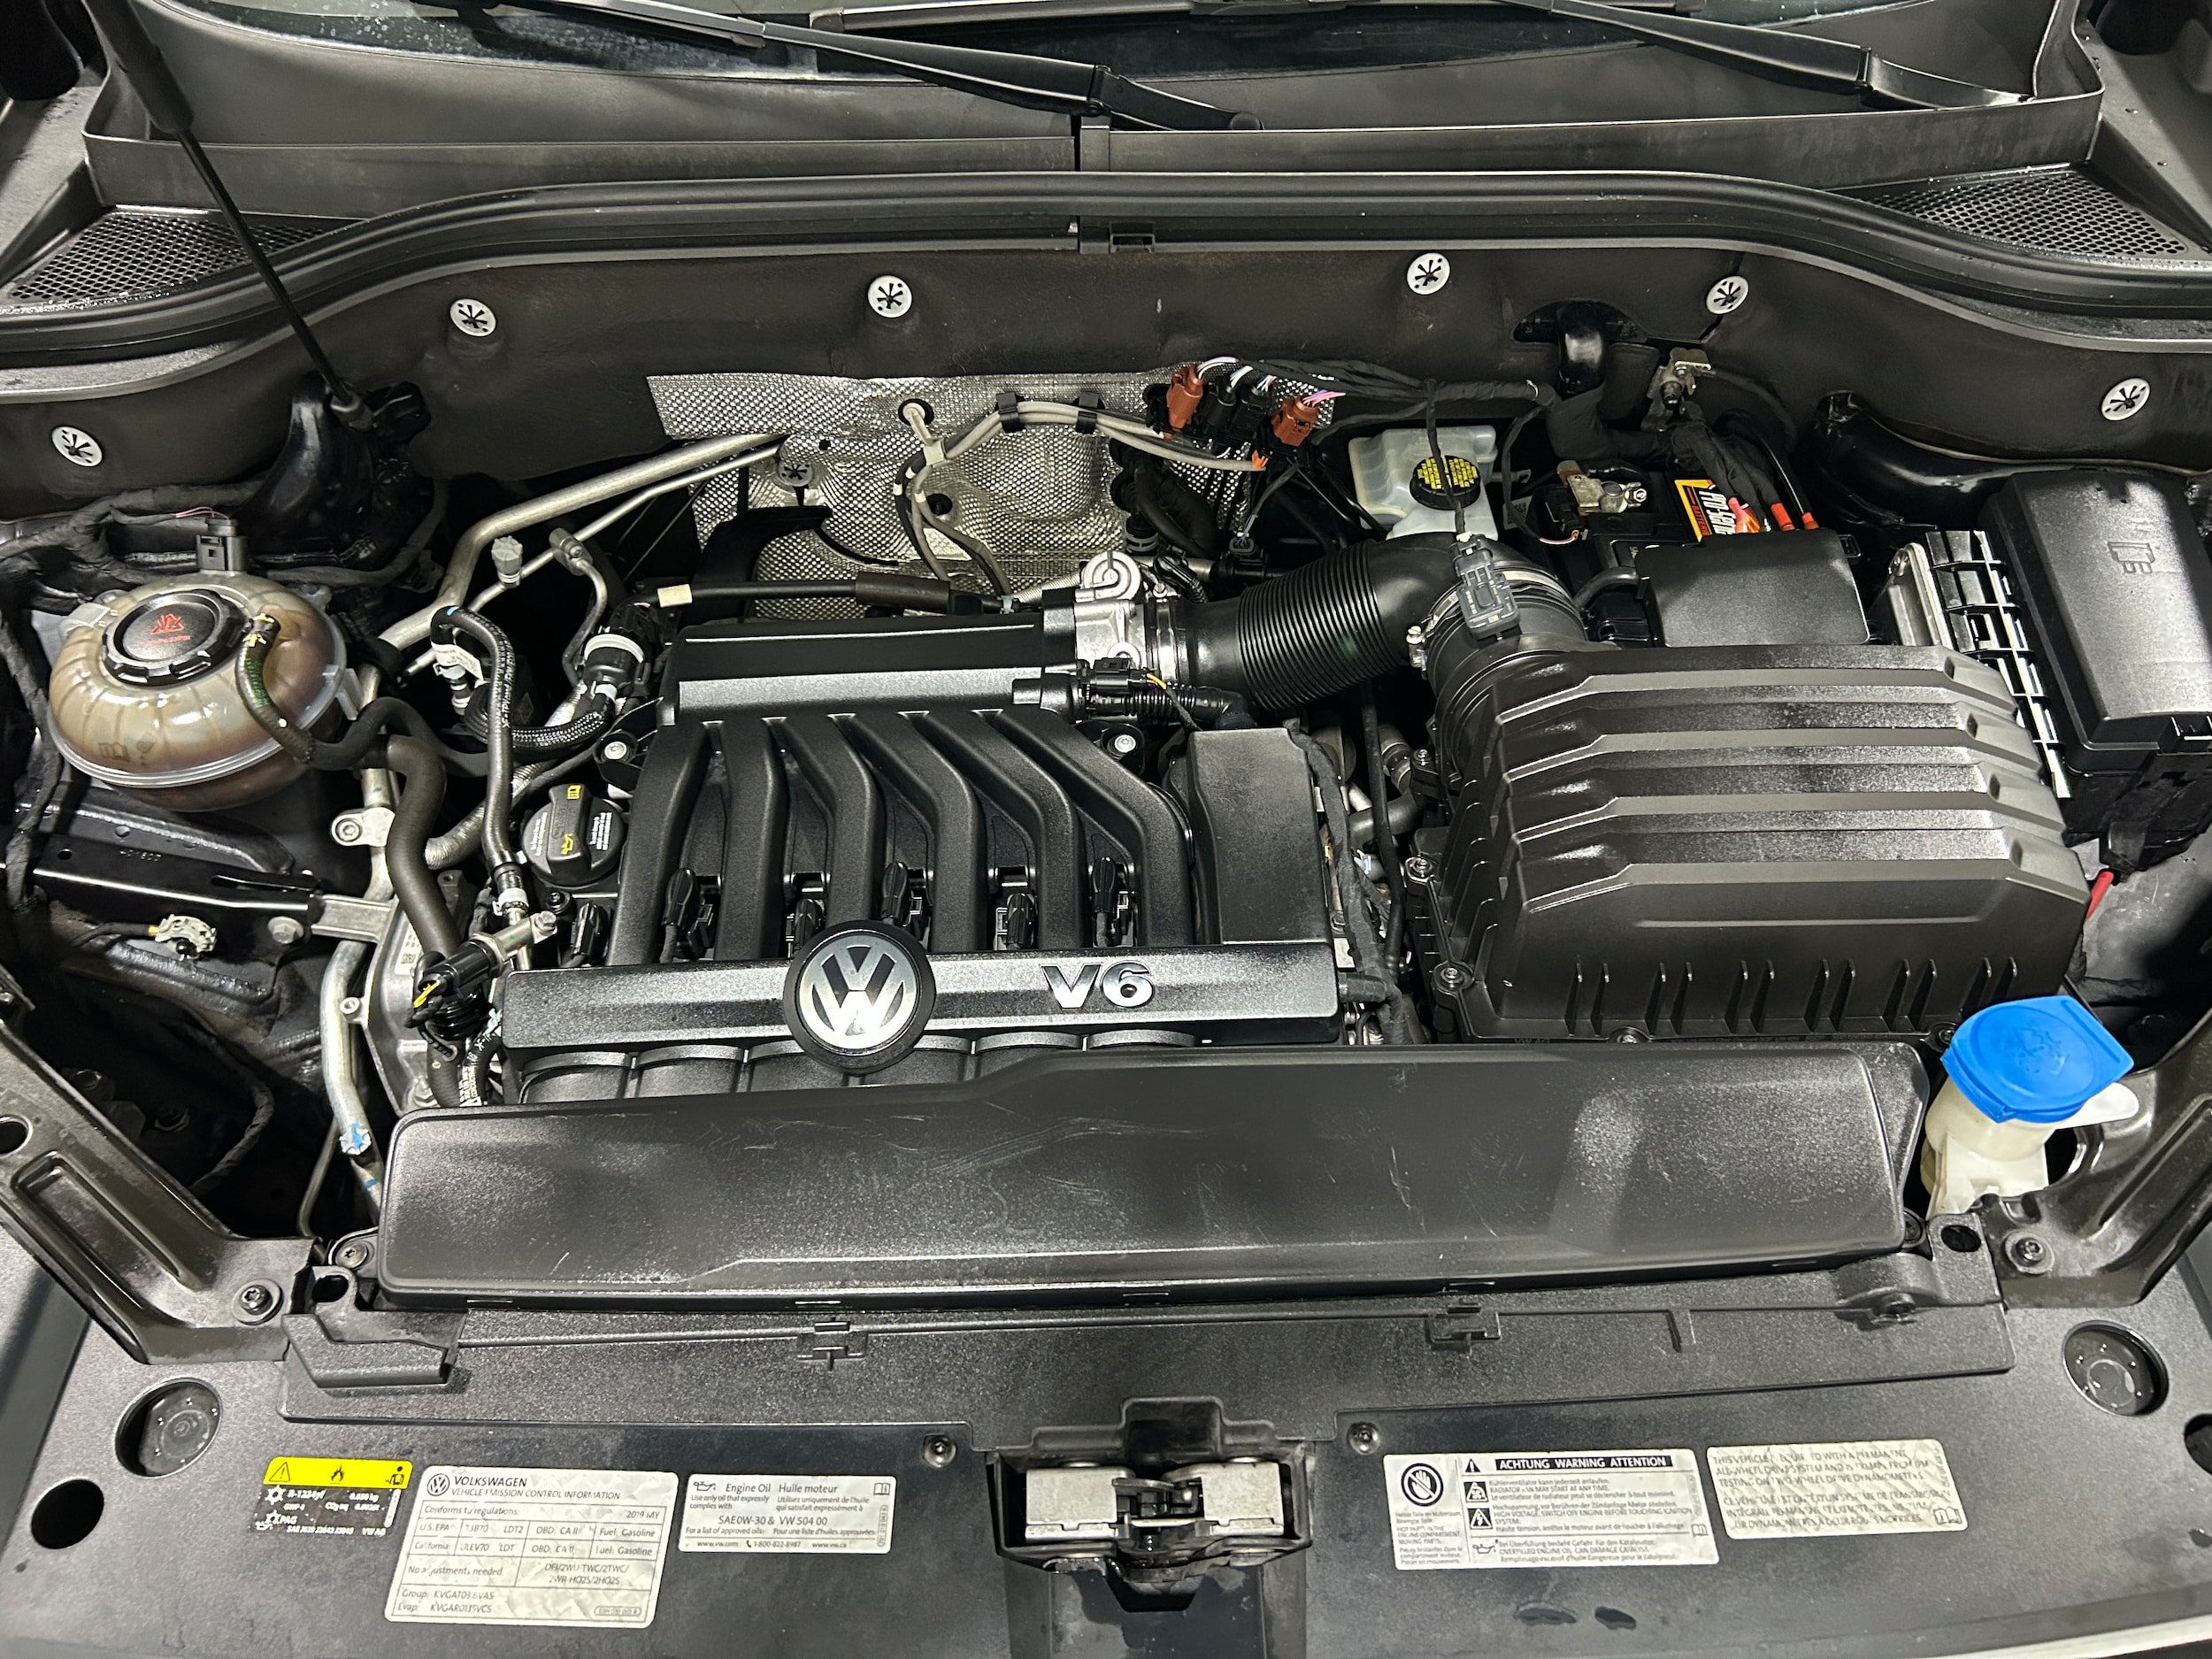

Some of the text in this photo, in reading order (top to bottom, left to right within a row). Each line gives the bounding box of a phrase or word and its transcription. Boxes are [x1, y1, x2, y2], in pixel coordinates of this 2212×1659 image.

[1040, 961, 1155, 1009] V6
[1499, 1456, 1666, 1469] ACHTUNG WARNING ATTENTION
[453, 1477, 527, 1486] VOLKSWAGEN
[726, 1484, 756, 1494] Engine
[779, 1483, 803, 1492] Huile
